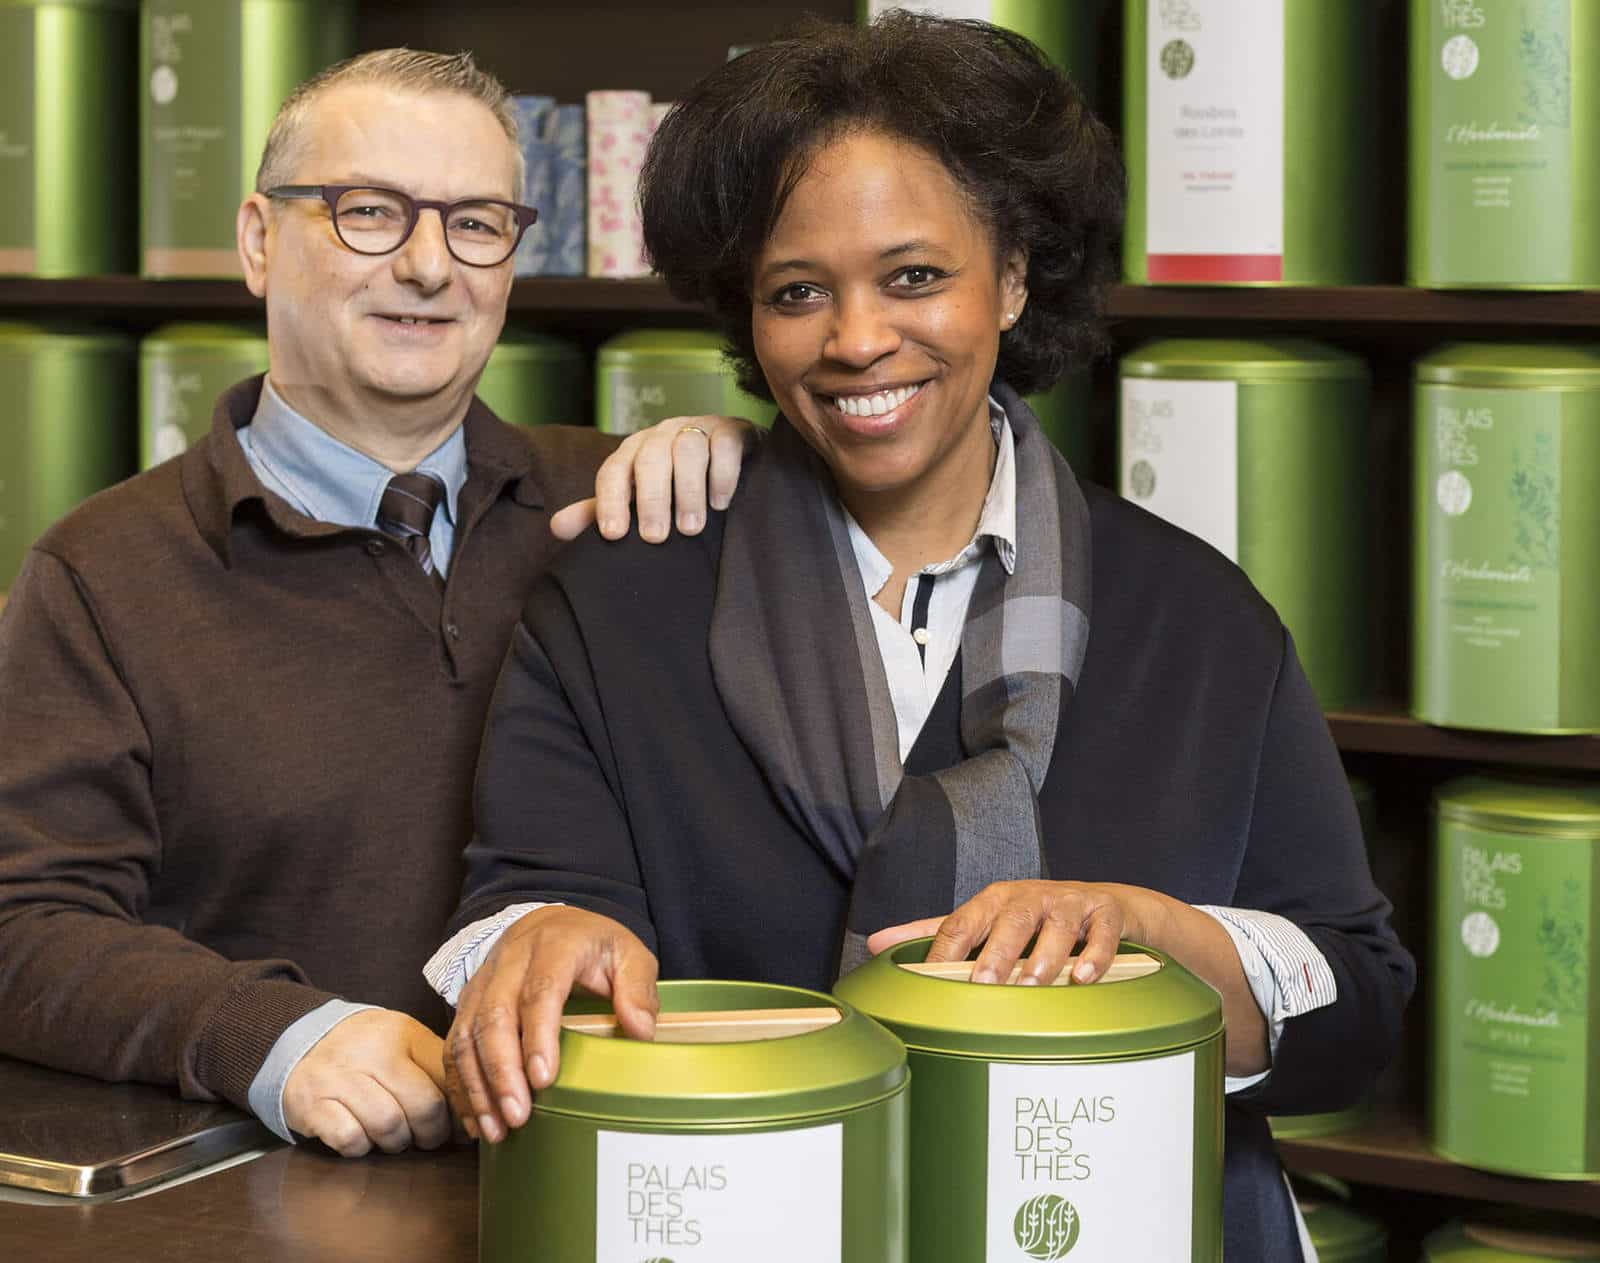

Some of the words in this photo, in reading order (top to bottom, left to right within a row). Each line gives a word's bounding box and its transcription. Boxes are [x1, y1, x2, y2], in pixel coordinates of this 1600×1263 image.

[1015, 1096, 1115, 1124] PALAIS
[1015, 1126, 1073, 1153] DES
[627, 1162, 728, 1191] PALAIS
[627, 1190, 683, 1218] DES
